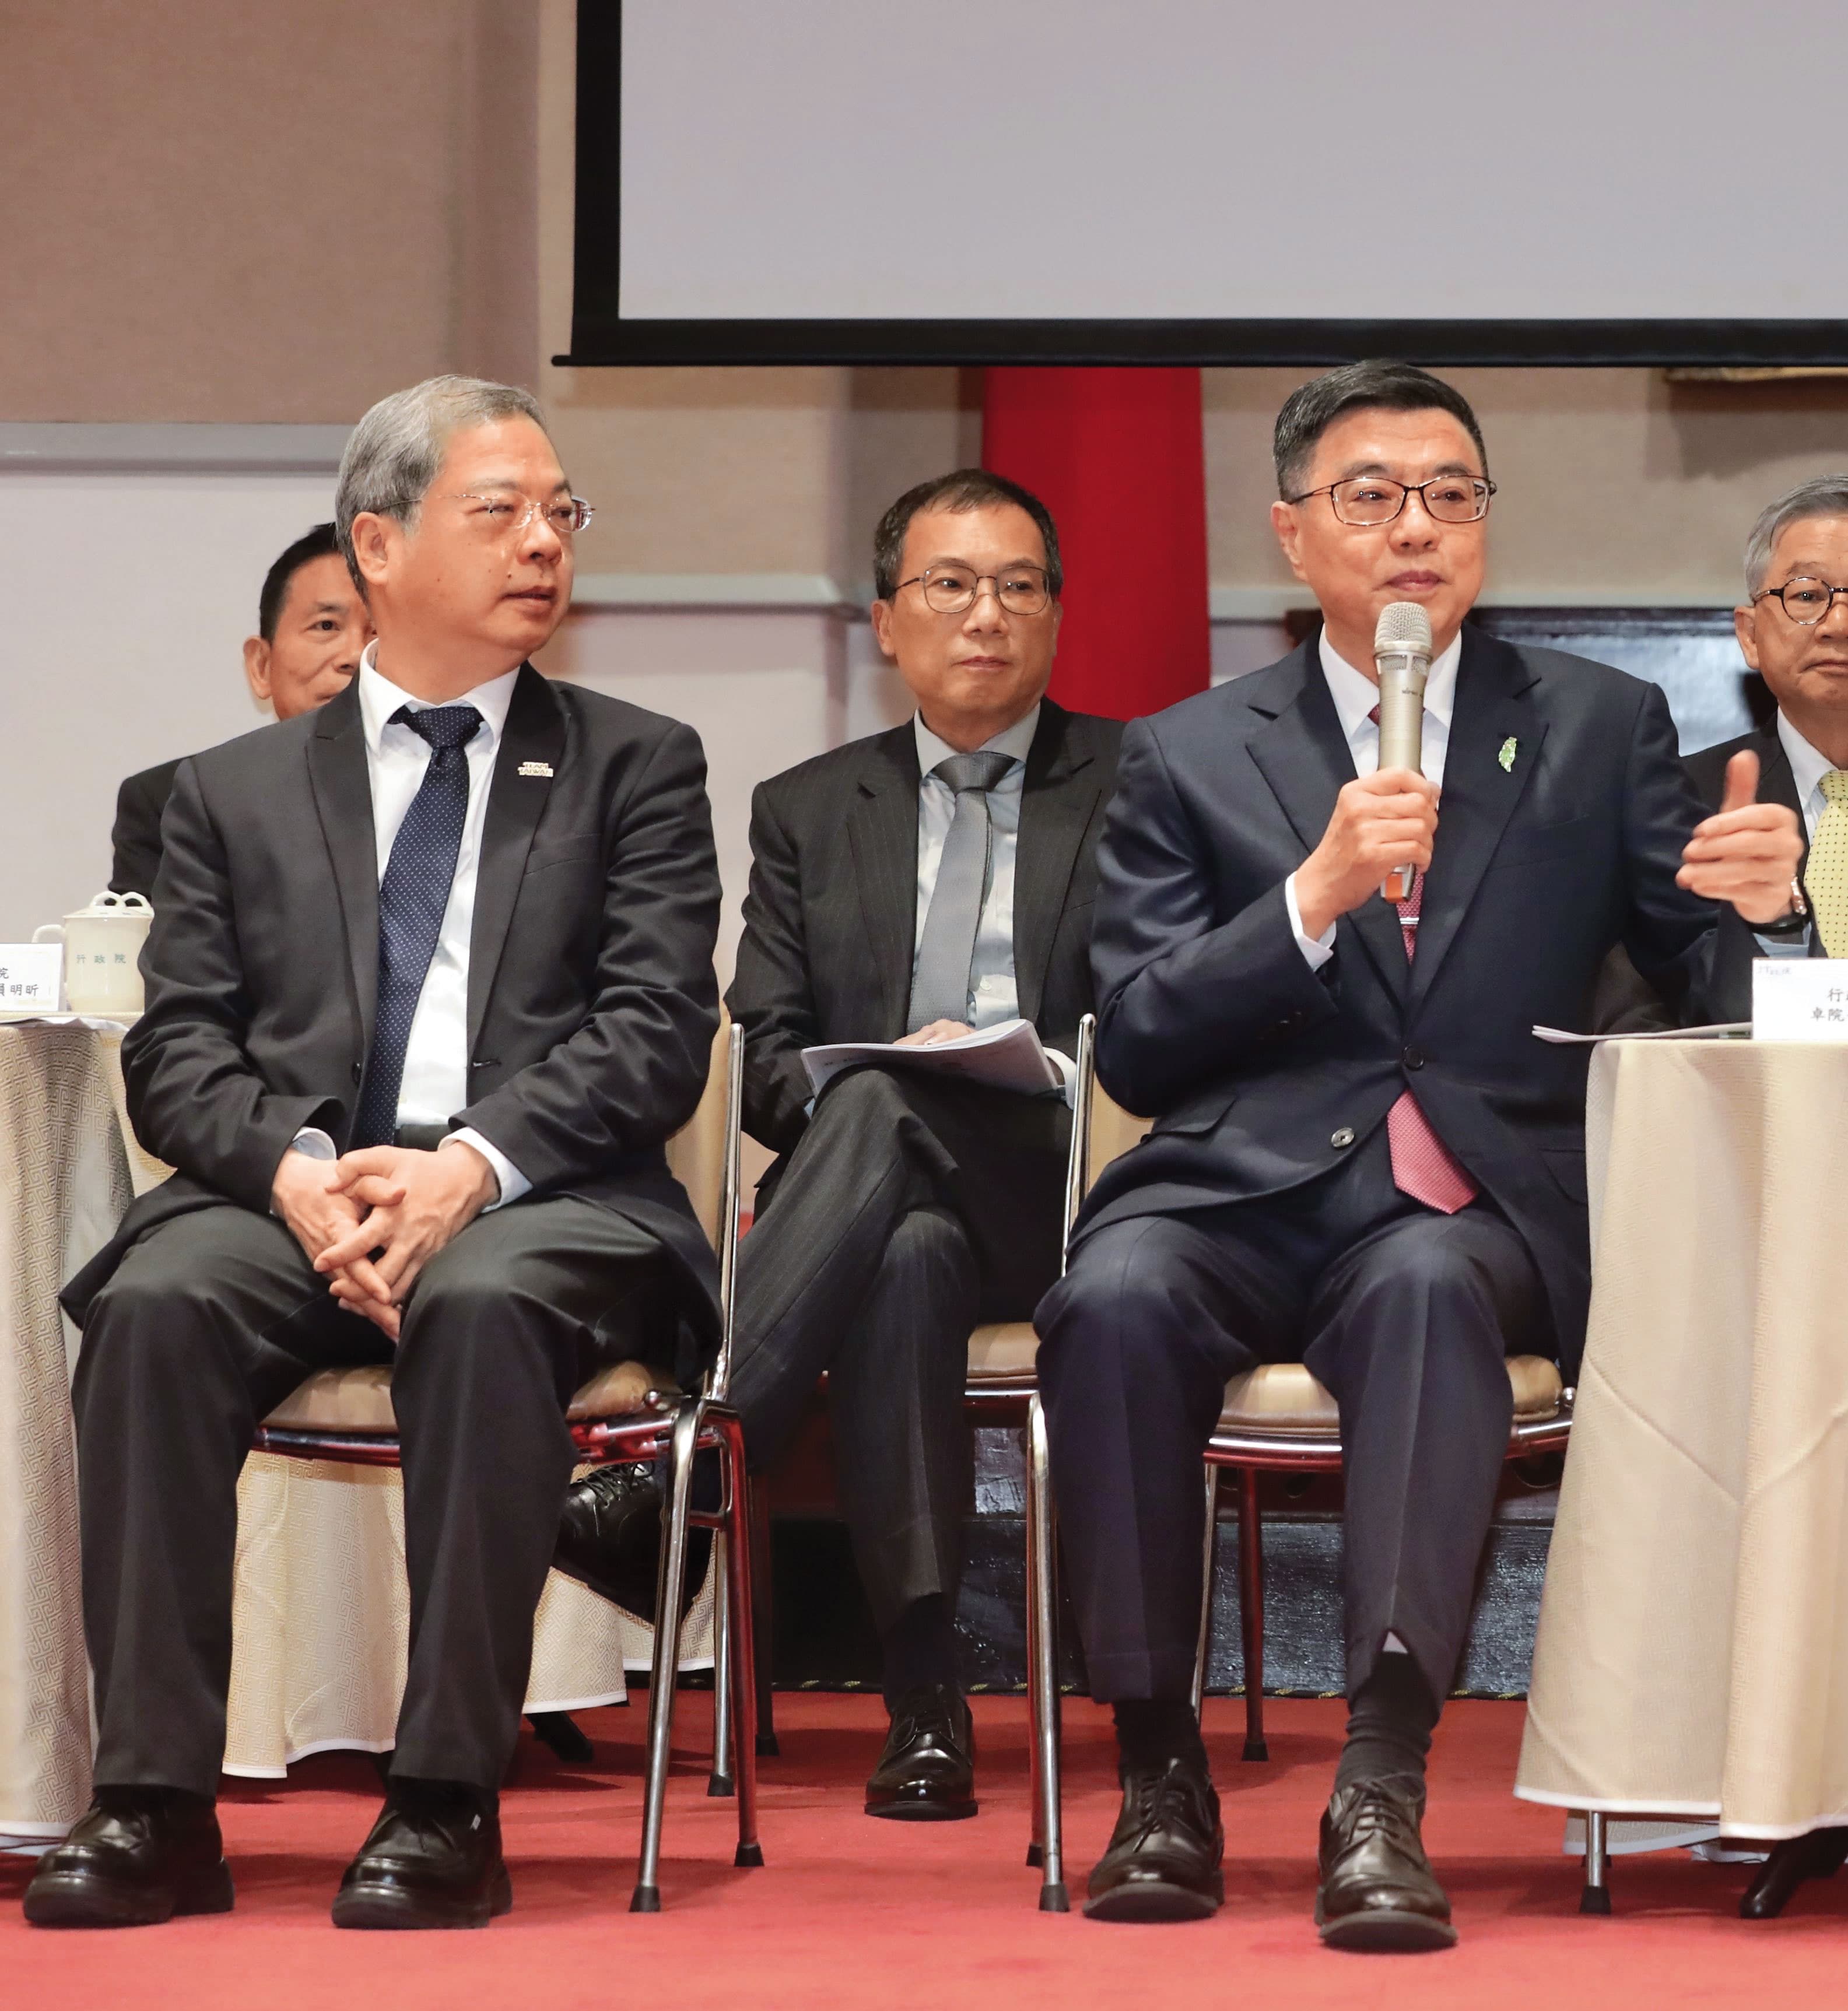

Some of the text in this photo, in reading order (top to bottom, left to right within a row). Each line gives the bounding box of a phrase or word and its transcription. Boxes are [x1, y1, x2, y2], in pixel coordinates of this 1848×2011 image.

[76, 953, 127, 964] 行政院
[1826, 987, 1848, 1002] 行
[1810, 1006, 1848, 1022] 卓院
